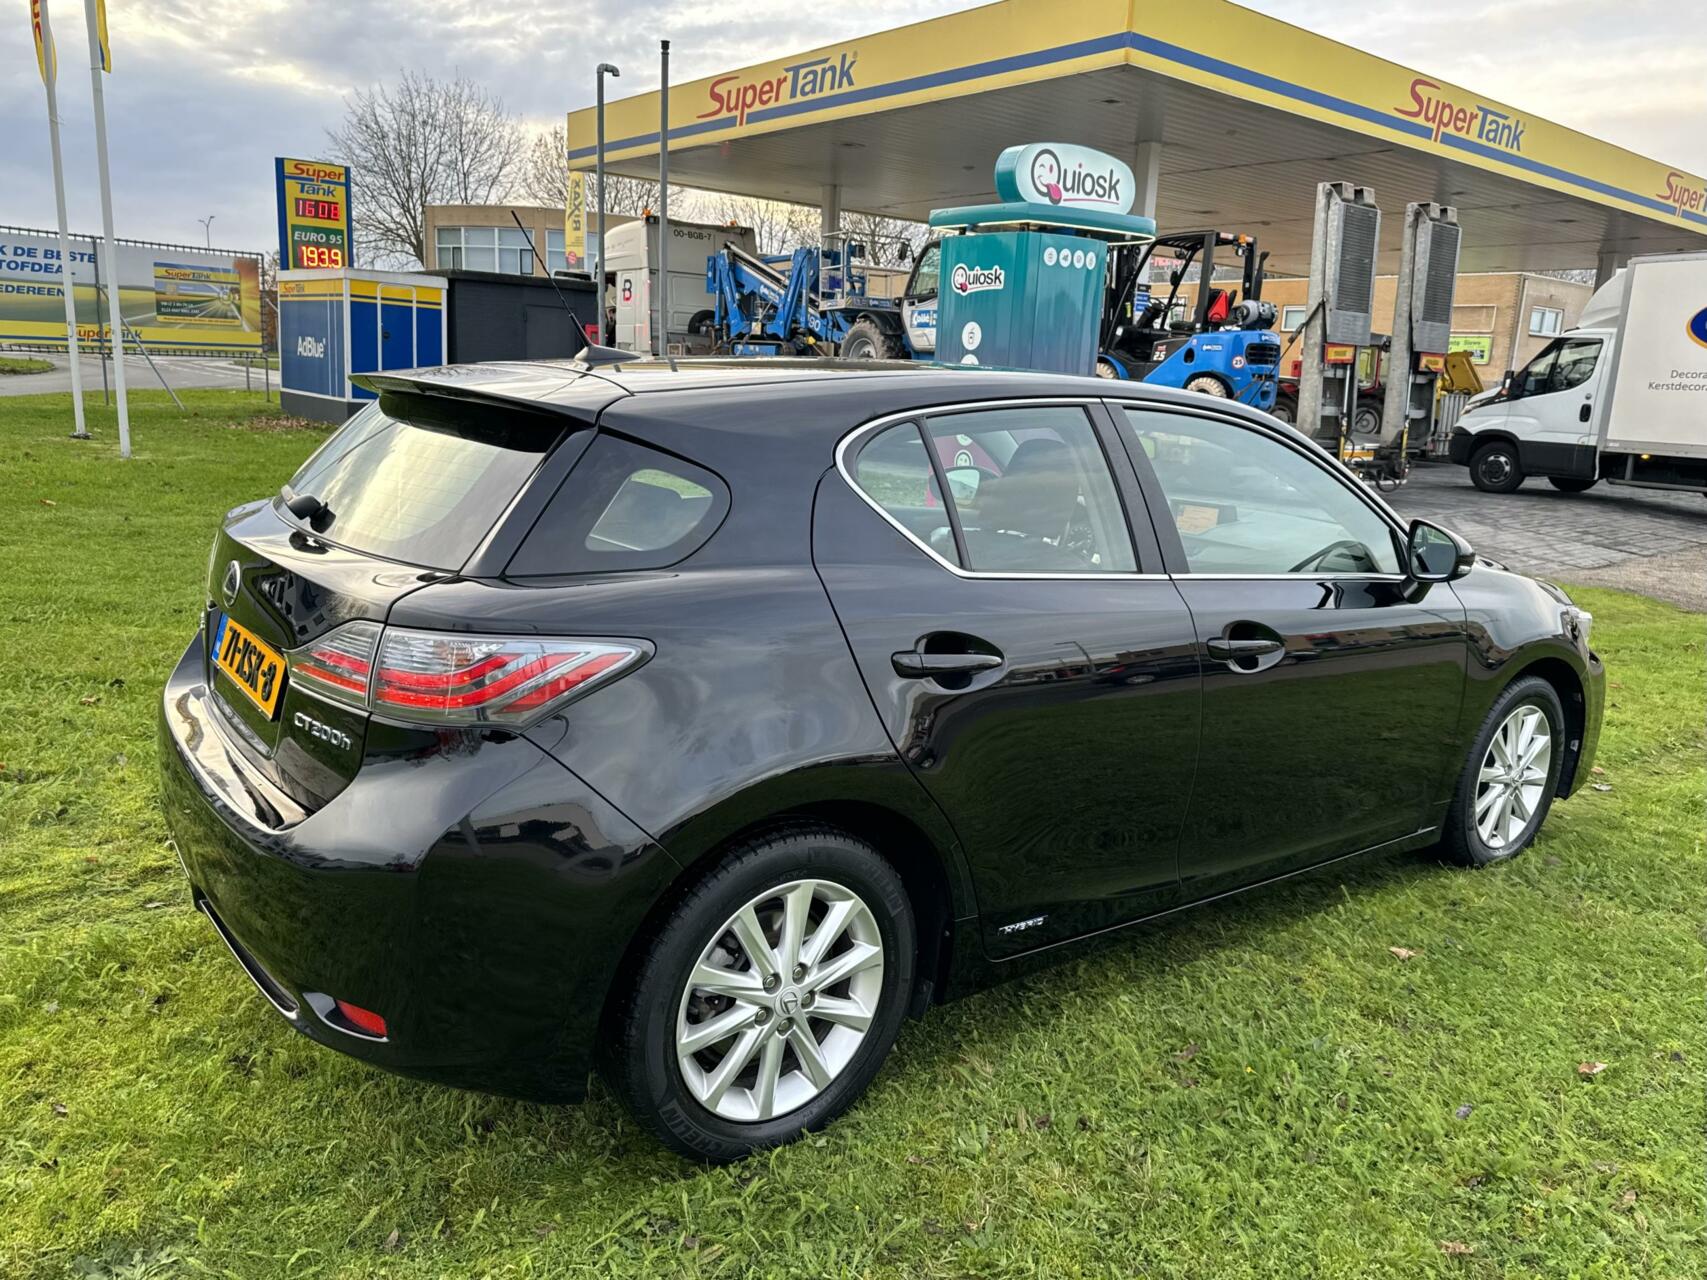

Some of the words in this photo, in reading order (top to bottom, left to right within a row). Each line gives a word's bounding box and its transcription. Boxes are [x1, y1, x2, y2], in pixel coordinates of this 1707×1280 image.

[284, 162, 344, 183] Super
[1031, 149, 1120, 205] Quiosk
[295, 182, 336, 198] Tank
[294, 231, 327, 243] EURO
[329, 235, 343, 245] 95
[13, 246, 38, 258] DE
[953, 265, 1002, 293] Quiosk
[1153, 352, 1166, 361] 25
[294, 711, 351, 750] CT200h
